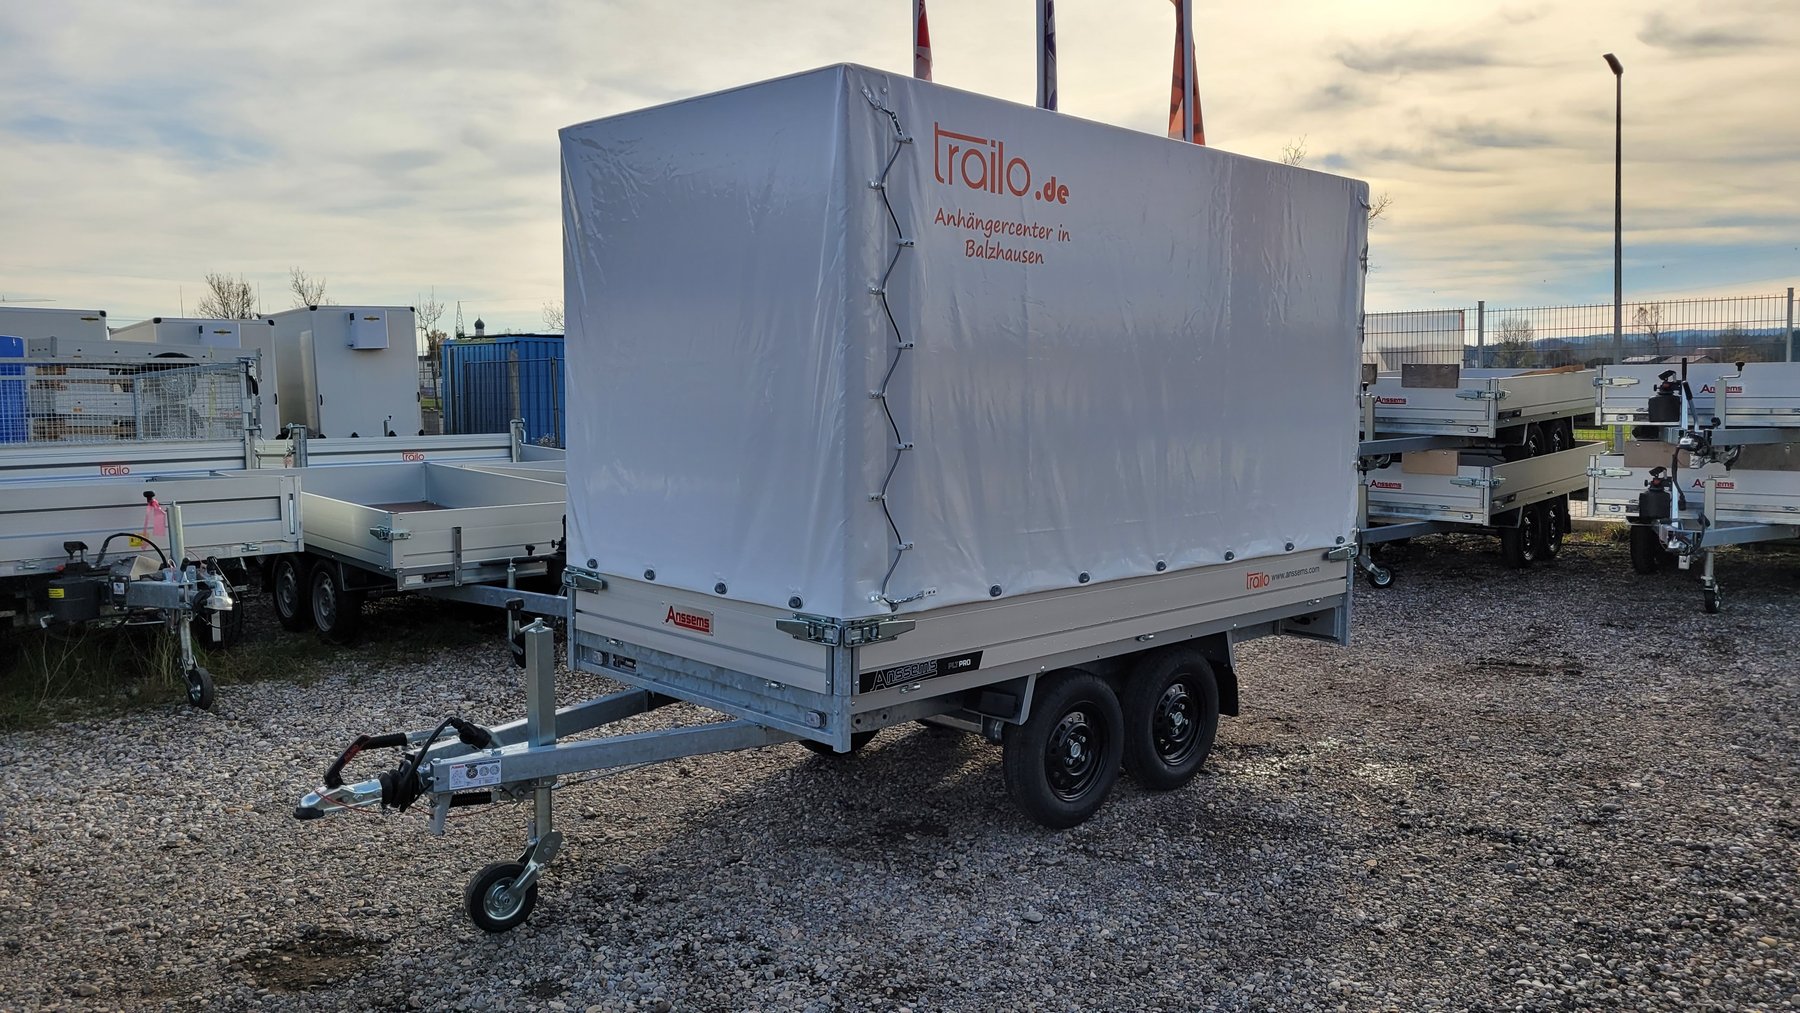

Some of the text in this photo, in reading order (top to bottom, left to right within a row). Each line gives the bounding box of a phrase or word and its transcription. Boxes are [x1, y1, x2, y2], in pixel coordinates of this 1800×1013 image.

[934, 207, 1071, 242] Anhängercenter in
[965, 239, 1044, 264] Balzhausen
[1700, 384, 1743, 394] Anems
[1271, 566, 1320, 581] www.anssems.com
[665, 605, 710, 633] Anssems
[870, 659, 938, 693] Anssems
